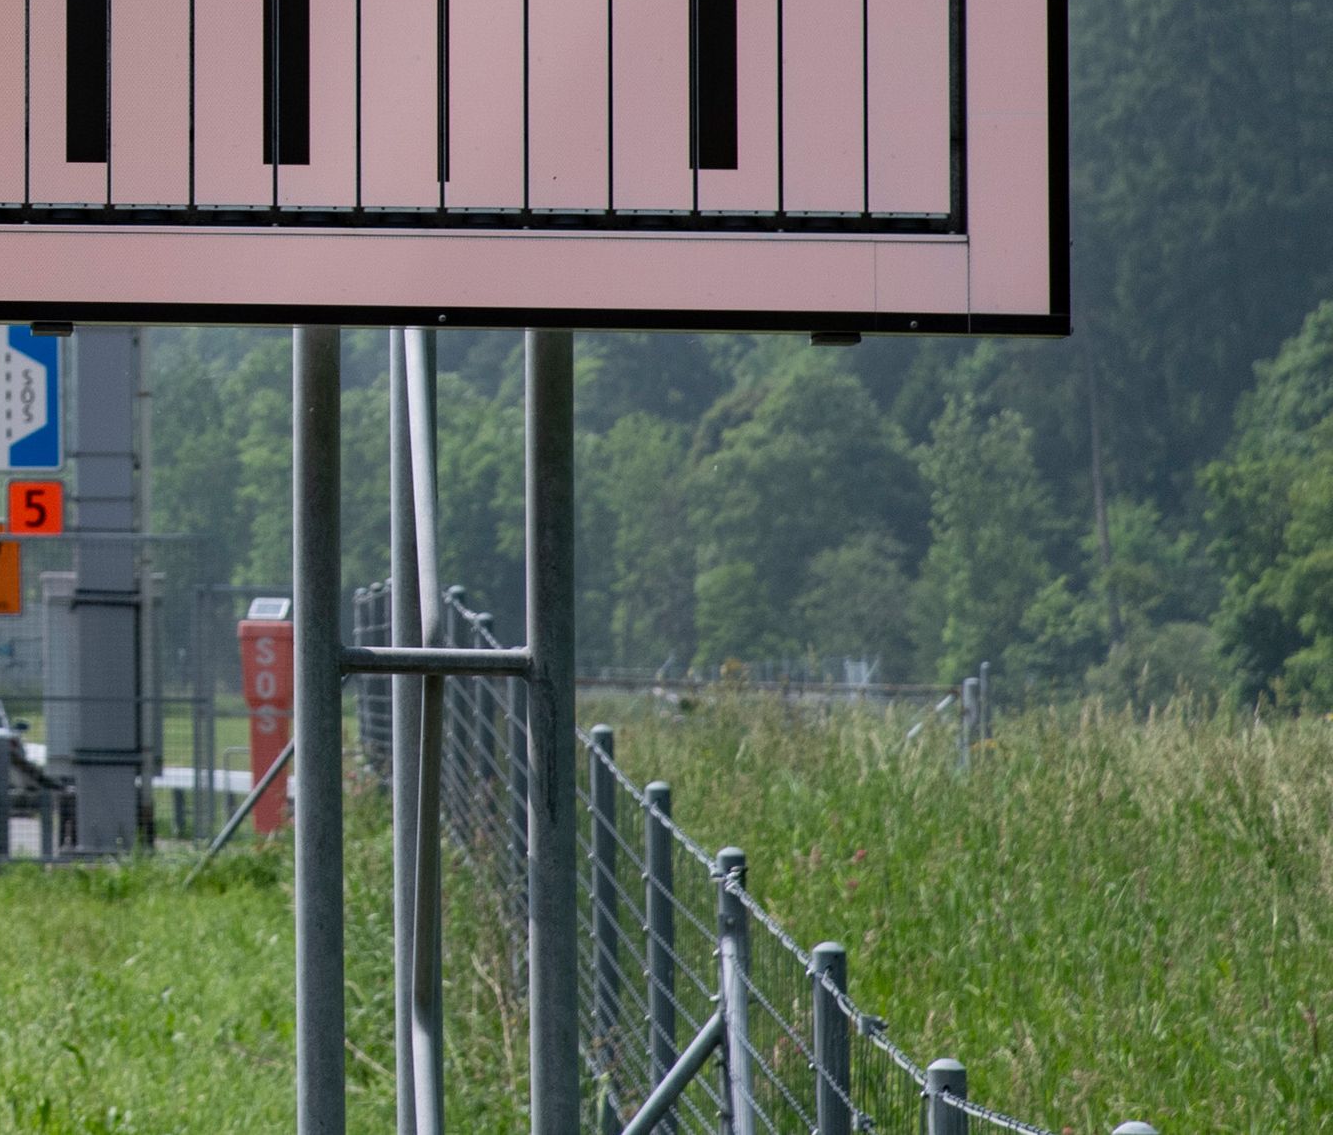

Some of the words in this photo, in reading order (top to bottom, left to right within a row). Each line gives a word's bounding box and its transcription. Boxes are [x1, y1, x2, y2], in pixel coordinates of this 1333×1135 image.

[20, 368, 36, 425] SOS
[25, 489, 47, 528] 5
[255, 635, 277, 735] SOS
